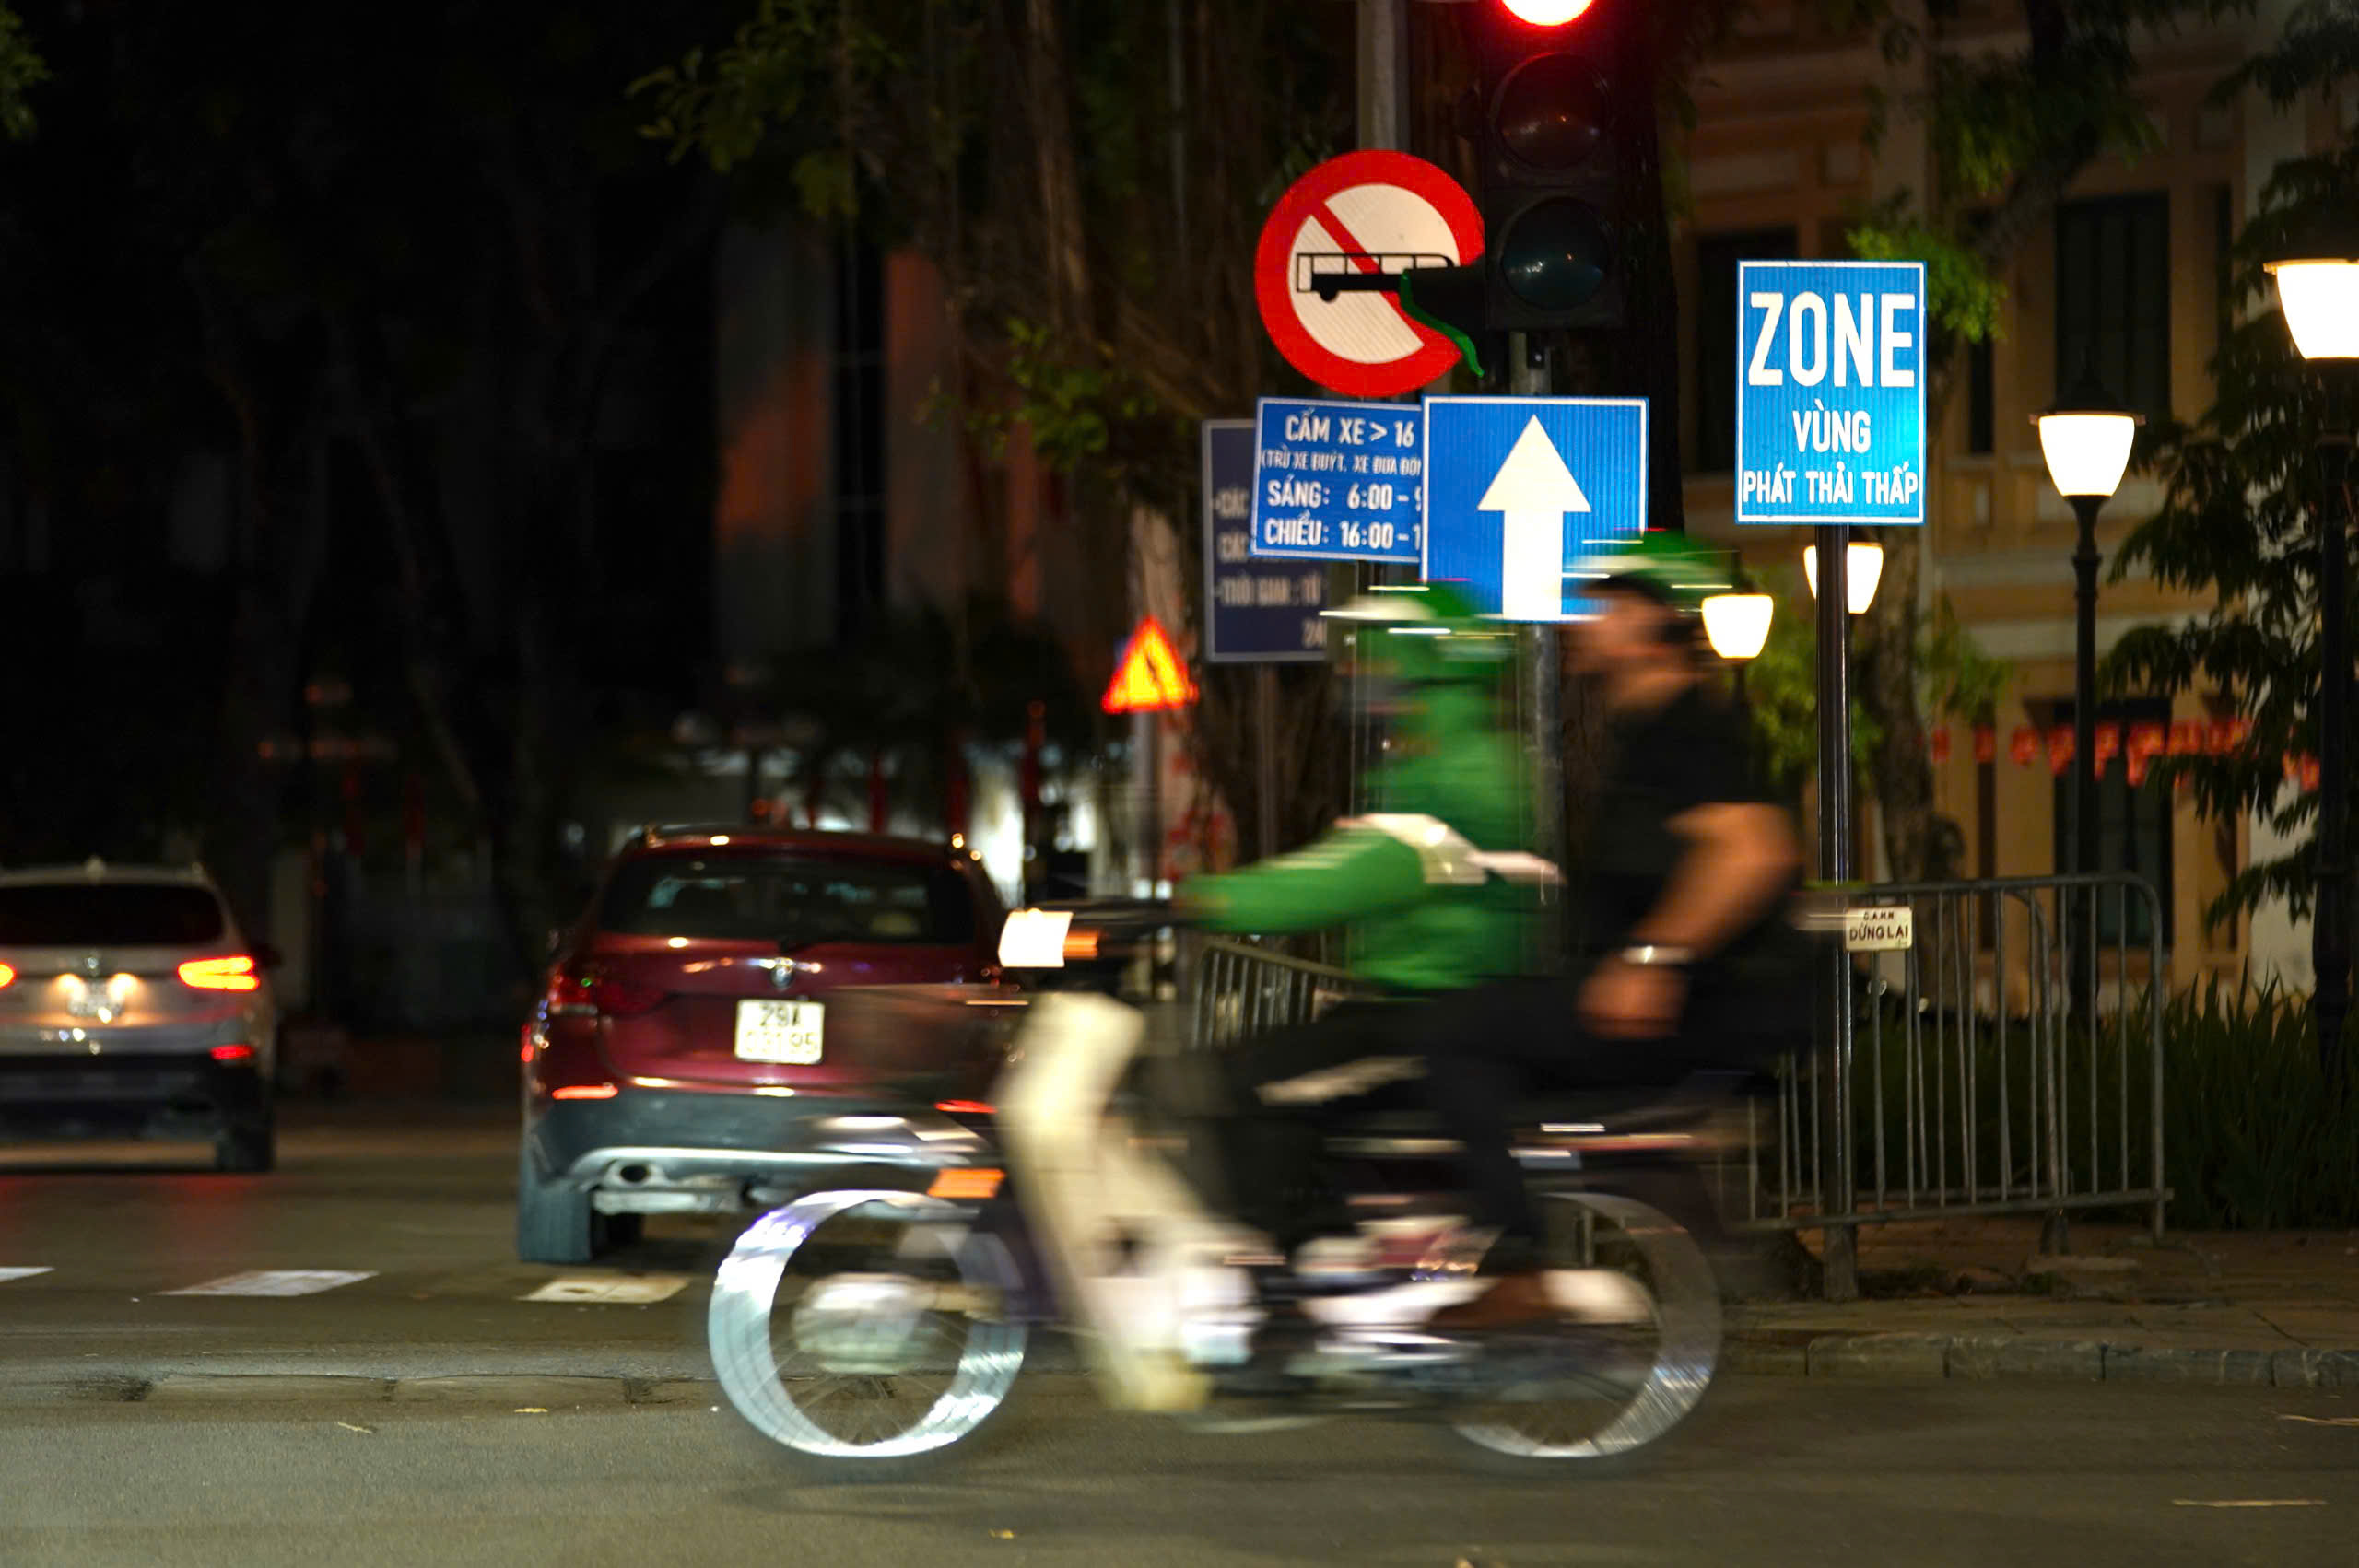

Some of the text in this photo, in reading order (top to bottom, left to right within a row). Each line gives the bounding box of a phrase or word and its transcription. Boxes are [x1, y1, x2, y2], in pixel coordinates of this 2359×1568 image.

[1748, 291, 1916, 387] ZONE
[1285, 406, 1414, 448] CẤM XE > 16
[1792, 398, 1872, 453] VÙNG
[1292, 450, 1309, 470] XE
[1353, 454, 1369, 474] XE
[1743, 461, 1919, 504] PHÁT THẢI THẤP
[1267, 474, 1330, 509] SÁNG:
[1347, 482, 1393, 511] 6:00
[1340, 520, 1394, 549] 16:00
